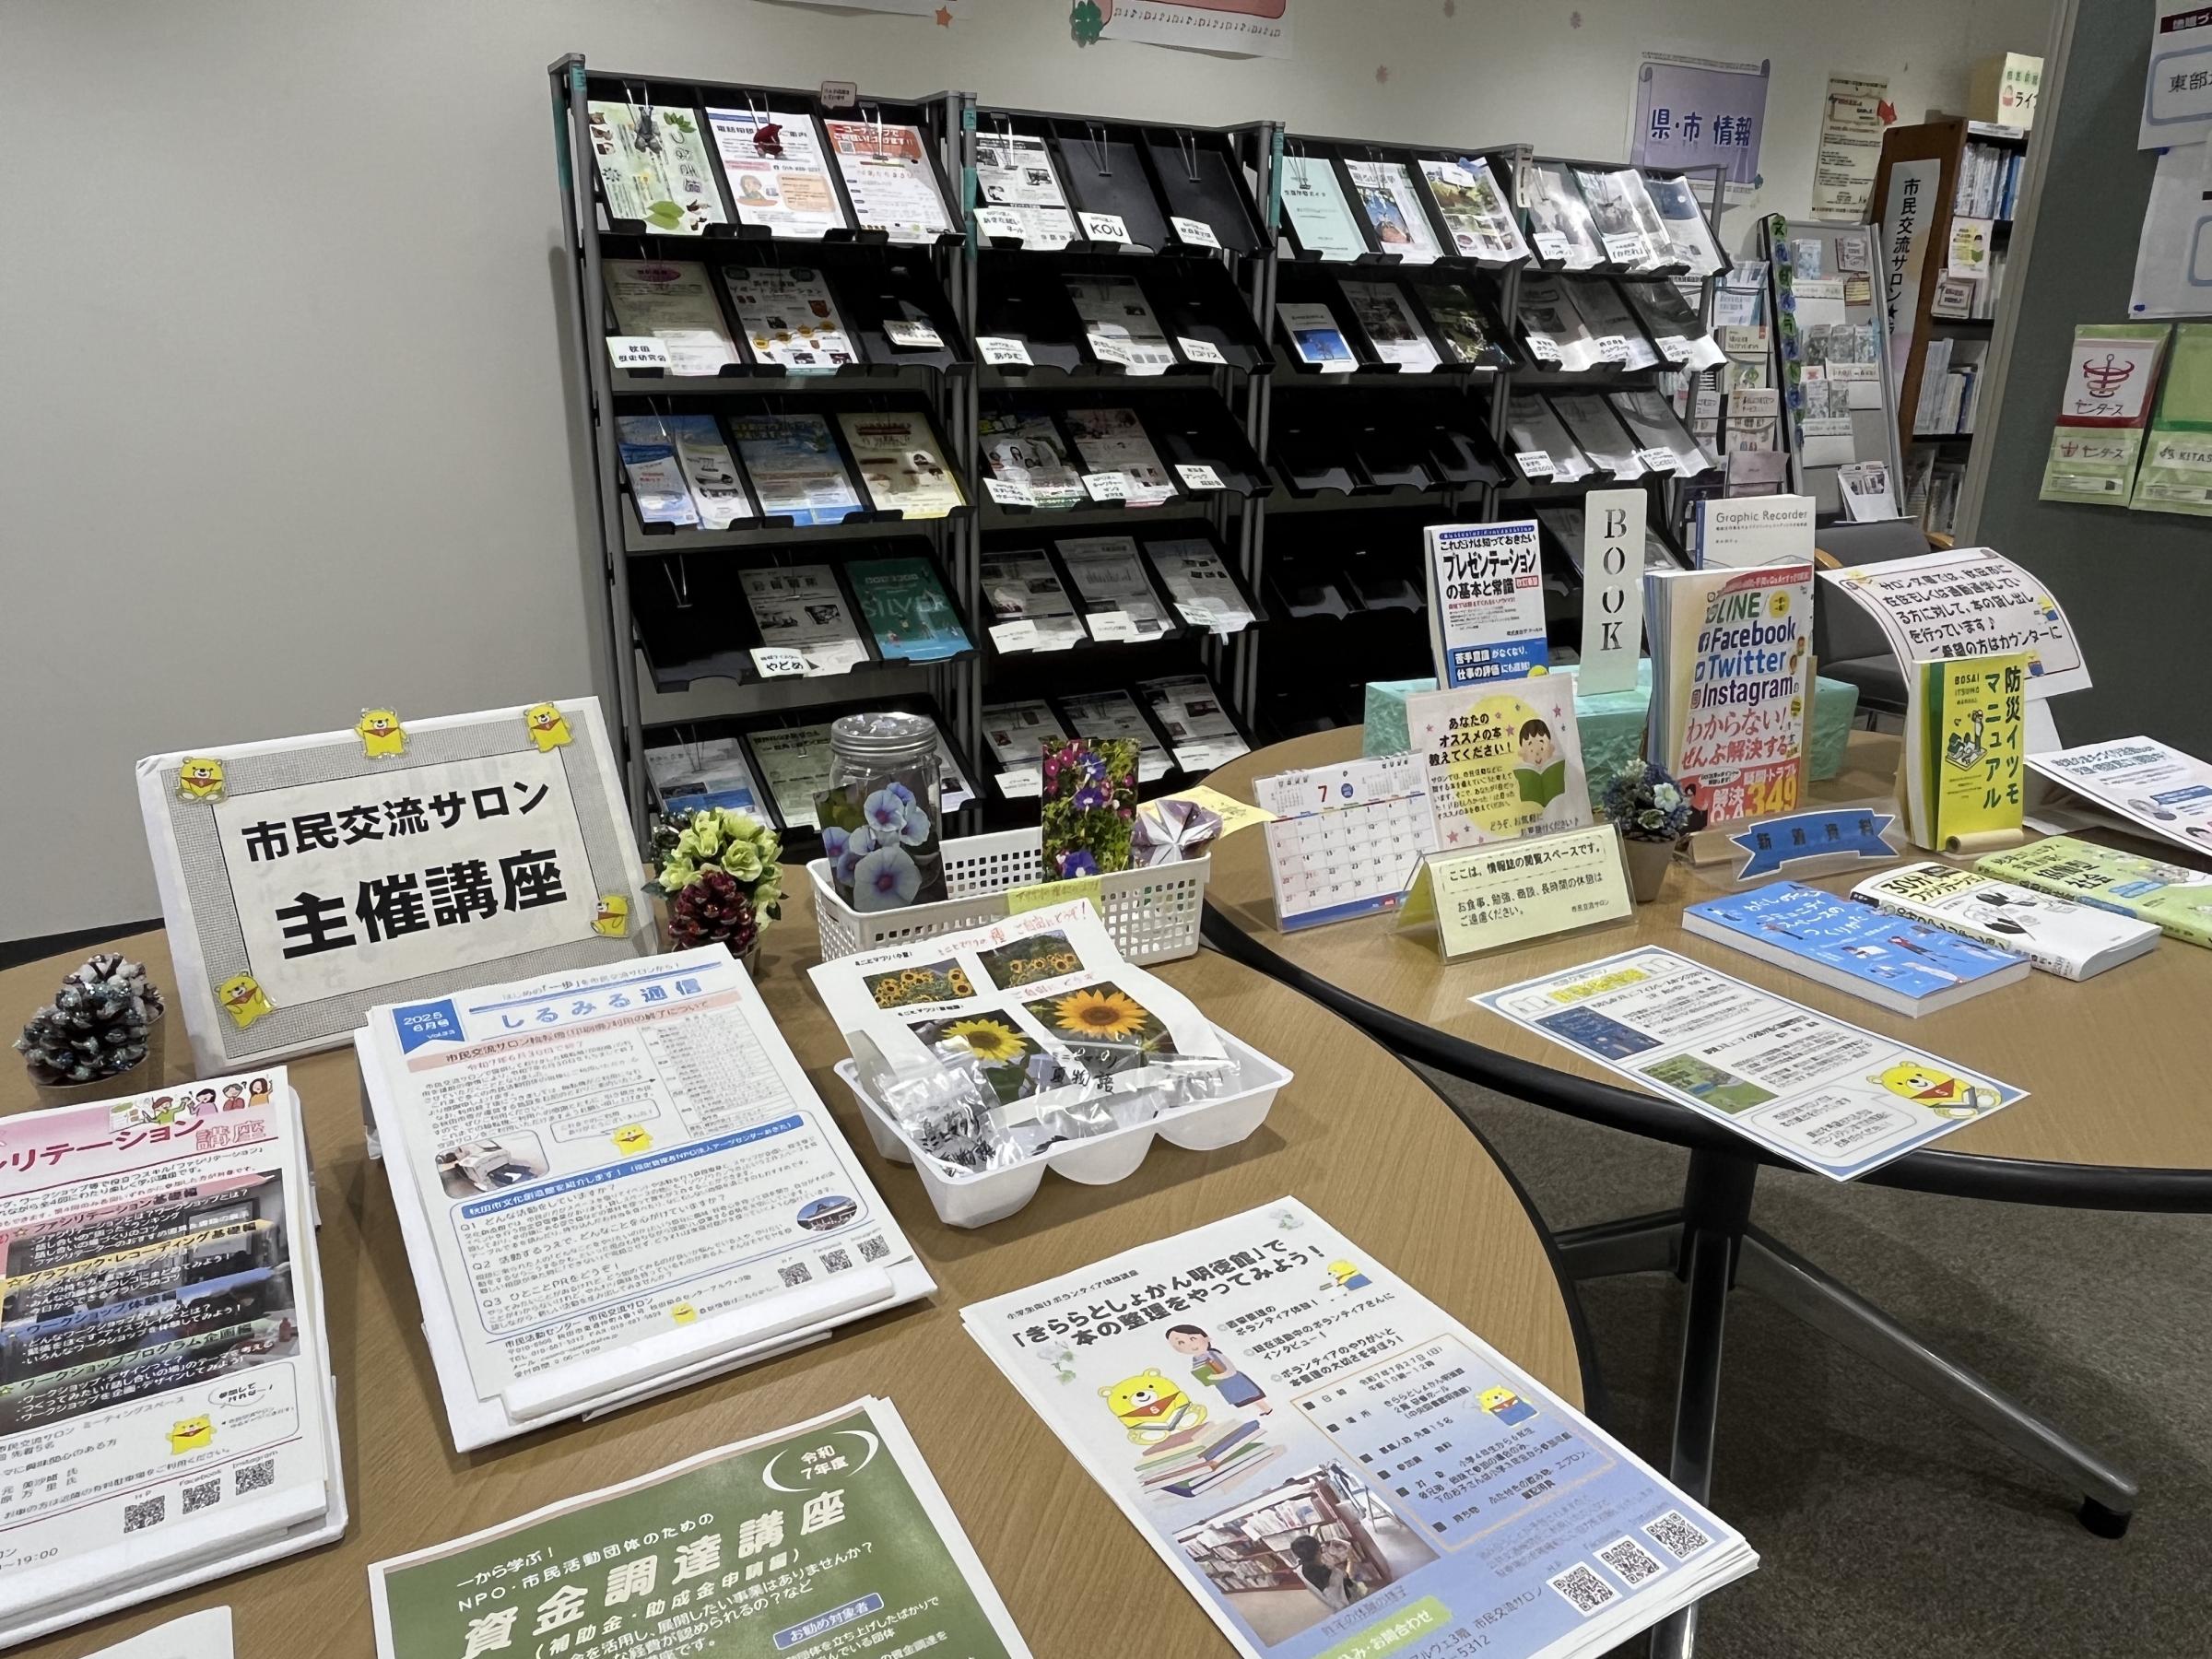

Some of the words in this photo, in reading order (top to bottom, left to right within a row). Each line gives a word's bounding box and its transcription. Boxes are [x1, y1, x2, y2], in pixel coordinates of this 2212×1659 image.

[2169, 70, 2212, 93] 東部
[1652, 109, 1702, 142] 県・市
[1714, 115, 1752, 147] 情報
[1090, 223, 1124, 237] KOU
[1716, 512, 1759, 524] Graphic
[1763, 510, 1807, 521] Recorder
[1443, 548, 1535, 582] プレゼンテーション
[1600, 509, 1628, 651] BOOK
[1447, 578, 1514, 599] の基本と常識
[1717, 593, 1761, 623] LINE
[1896, 595, 2034, 625] る方に対して、本の貸し出し
[1711, 616, 1796, 652] Facebook
[1709, 649, 1786, 680] Twitter
[1955, 674, 1980, 685] BOSAI
[1702, 676, 1793, 708] Instagram
[1440, 727, 1502, 748] オススメの本
[1449, 713, 1489, 731] あなたの
[2005, 665, 2021, 805] 防災イツモ
[1429, 742, 1514, 767] 教えてください!
[1983, 673, 2002, 809] マニュアル
[1318, 785, 1327, 803] 7
[1745, 774, 1797, 817] 349
[241, 781, 550, 862] 市民交流サロン
[1450, 841, 1601, 881] ここは、情報誌の閲覧スペースです。
[275, 849, 568, 959] 主催講座
[1757, 899, 1827, 922] コミュニティ
[1804, 915, 1869, 935] つくりかた
[402, 1011, 442, 1025] 2025
[499, 977, 703, 1030] しるみる通信
[412, 1018, 450, 1032] 6月号
[195, 1119, 267, 1151] 講座
[33, 1187, 198, 1233] ファシリテーション基礎編
[459, 1219, 477, 1232] Q1
[481, 1182, 618, 1227] どんな活動をしていますか?
[27, 1221, 257, 1285] グラフィック・レコーディング基礎編
[471, 1259, 491, 1272] Q2
[481, 1295, 503, 1310] Q3
[508, 1261, 620, 1302] ひとことPRをどうぞ!
[1008, 1238, 1293, 1349] 「きららとしょかん明徳館」で
[1067, 1243, 1330, 1348] 本の整理をやってみよう!
[26, 1289, 177, 1335] ワークショップ体験編
[586, 1294, 656, 1324] 市民交流サロン
[1231, 1298, 1322, 1336] ボランティア体験!
[1249, 1290, 1398, 1354] 現在活動中のボランティアさんに
[20, 1322, 253, 1391] ワークショッププログラム企画編
[1259, 1330, 1330, 1362] インタビュー!
[1277, 1325, 1399, 1380] ボランティアのやりがいと
[82, 1394, 185, 1430] ミーティングスペース
[797, 1443, 840, 1466] 令和
[798, 1454, 852, 1481] 7年度
[178, 1468, 222, 1487] Facebook
[453, 1545, 557, 1592] 一から学ぶ!
[454, 1511, 722, 1613] NPO・市民活動団体のための
[462, 1488, 846, 1659] 資金調達講座
[790, 1601, 868, 1641] お勧め対象者
[1474, 1586, 1544, 1630] 市民交流サロン
